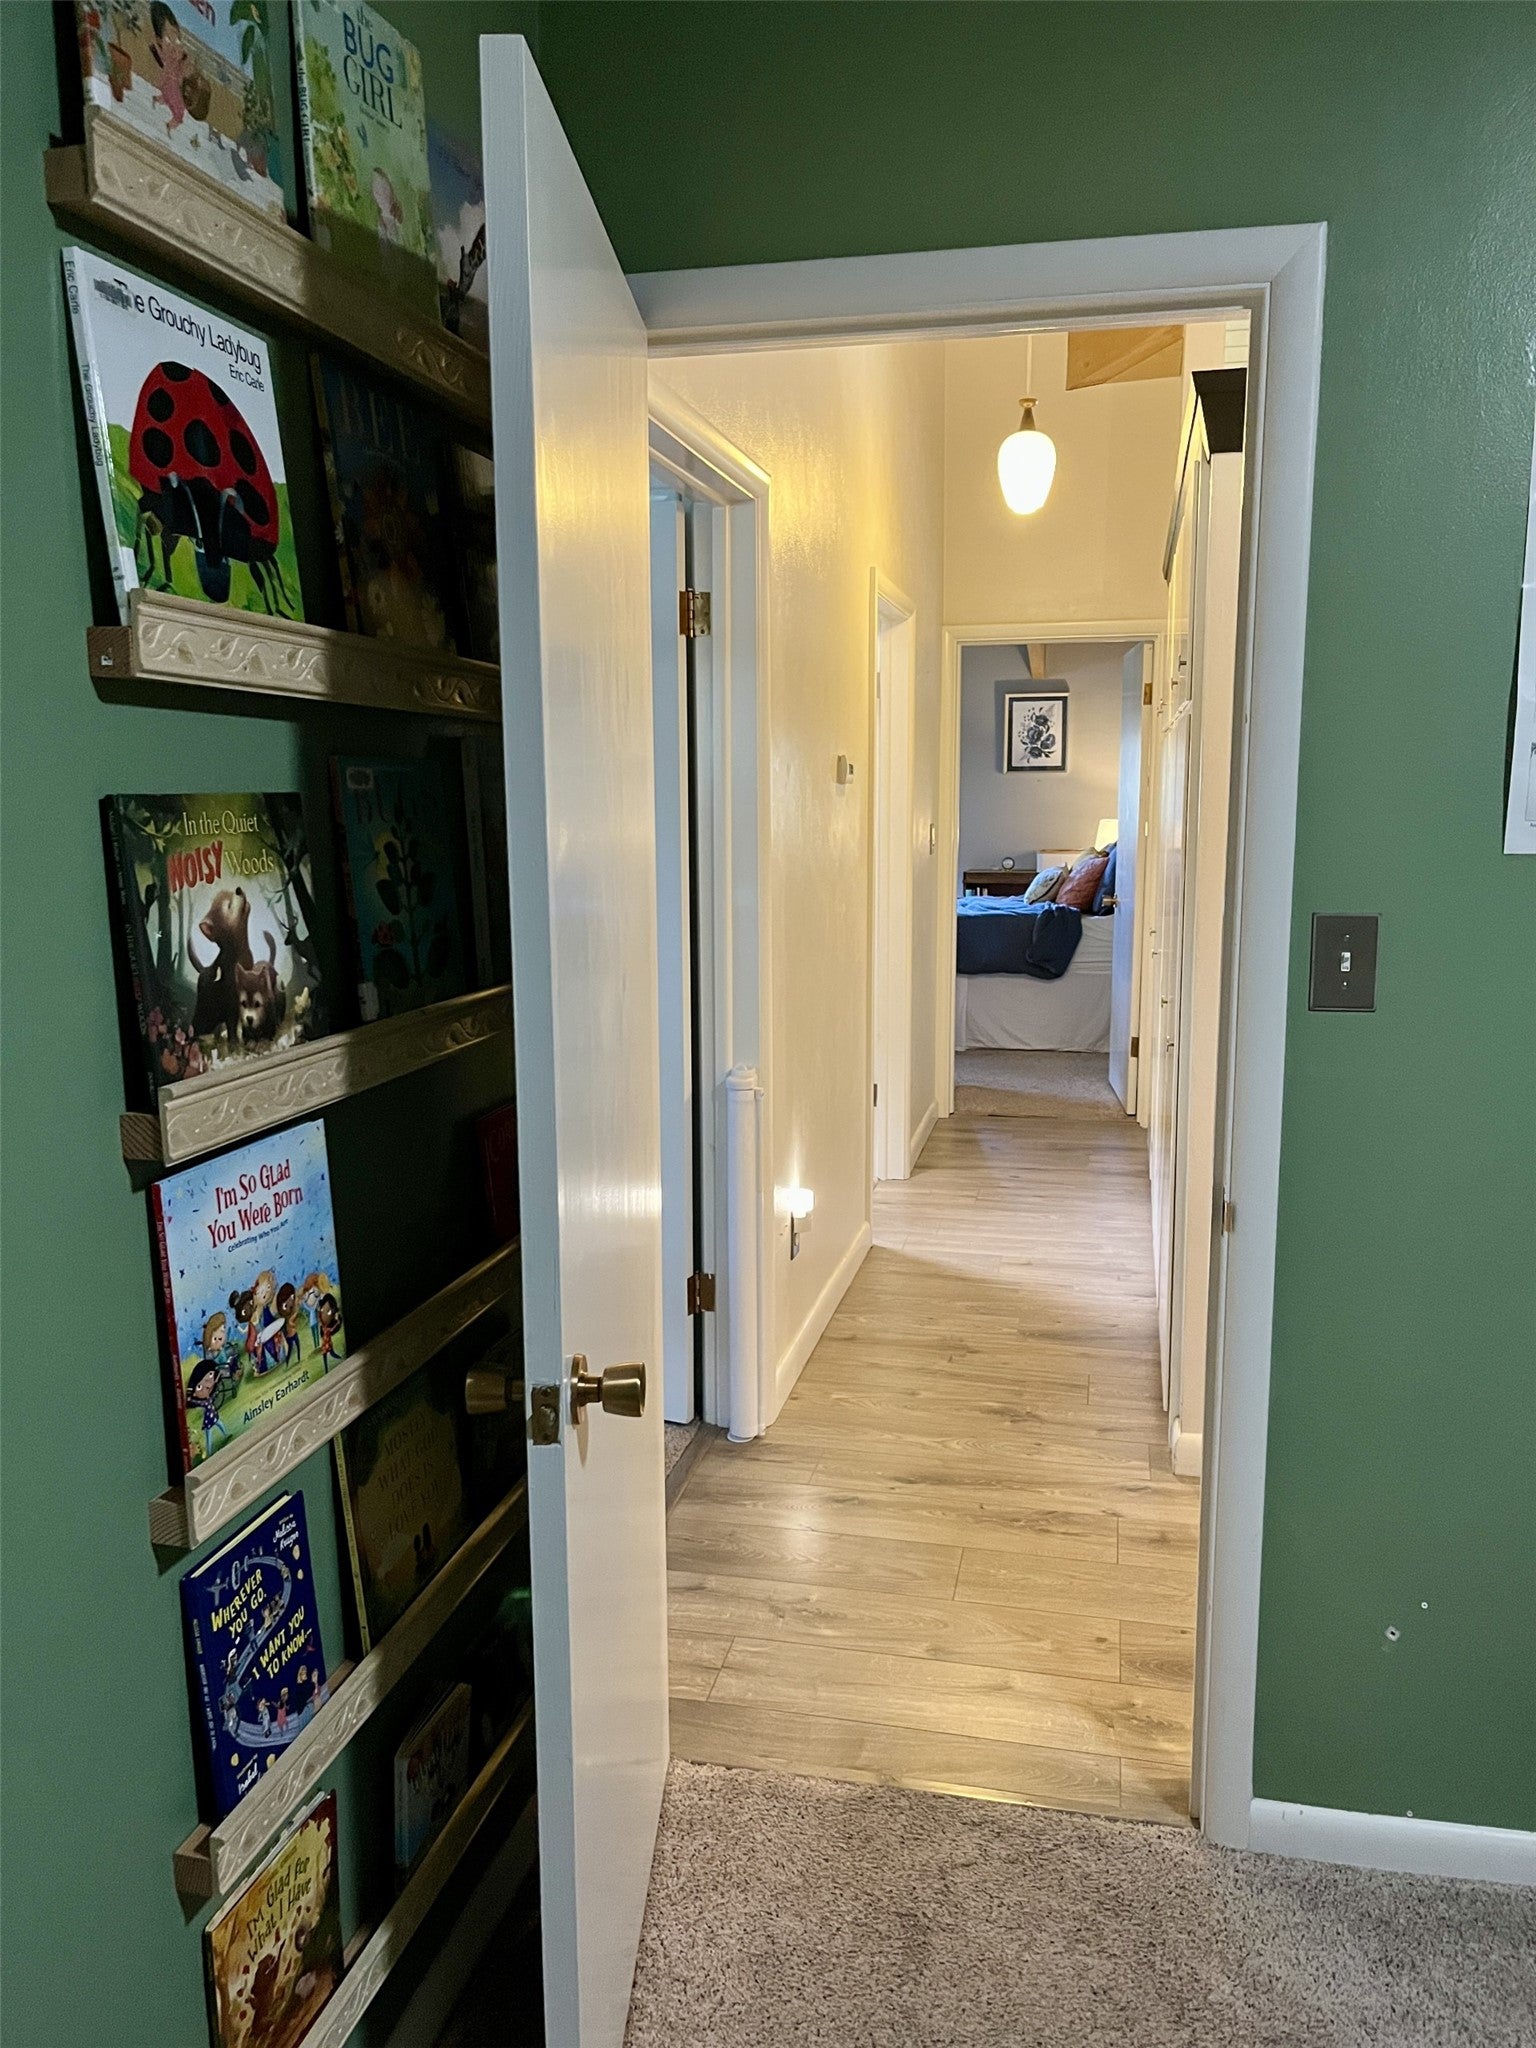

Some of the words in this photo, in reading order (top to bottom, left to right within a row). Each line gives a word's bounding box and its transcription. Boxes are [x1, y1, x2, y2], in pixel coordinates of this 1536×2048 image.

[343, 11, 394, 84] BUG
[344, 54, 402, 130] GIRL
[148, 295, 205, 347] Grouchy
[207, 324, 261, 375] Ladybug
[229, 363, 245, 382] Eric
[245, 372, 265, 392] Carle
[183, 812, 197, 835] In
[200, 812, 220, 834] the
[222, 810, 259, 834] Quiet
[168, 839, 223, 893] NOISY
[224, 849, 274, 876] Woods
[207, 1219, 236, 1248] You
[238, 1201, 272, 1231] Were
[273, 1187, 303, 1218] Born
[215, 1187, 238, 1214] I'm
[239, 1174, 257, 1200] So
[243, 1396, 274, 1425] Ainsley
[275, 1370, 310, 1402] Earhardt
[211, 1568, 262, 1632] WHEREVER
[229, 1607, 248, 1639] YOU
[260, 1629, 285, 1668] WANT
[288, 1605, 304, 1635] YOU
[266, 1657, 280, 1679] TO
